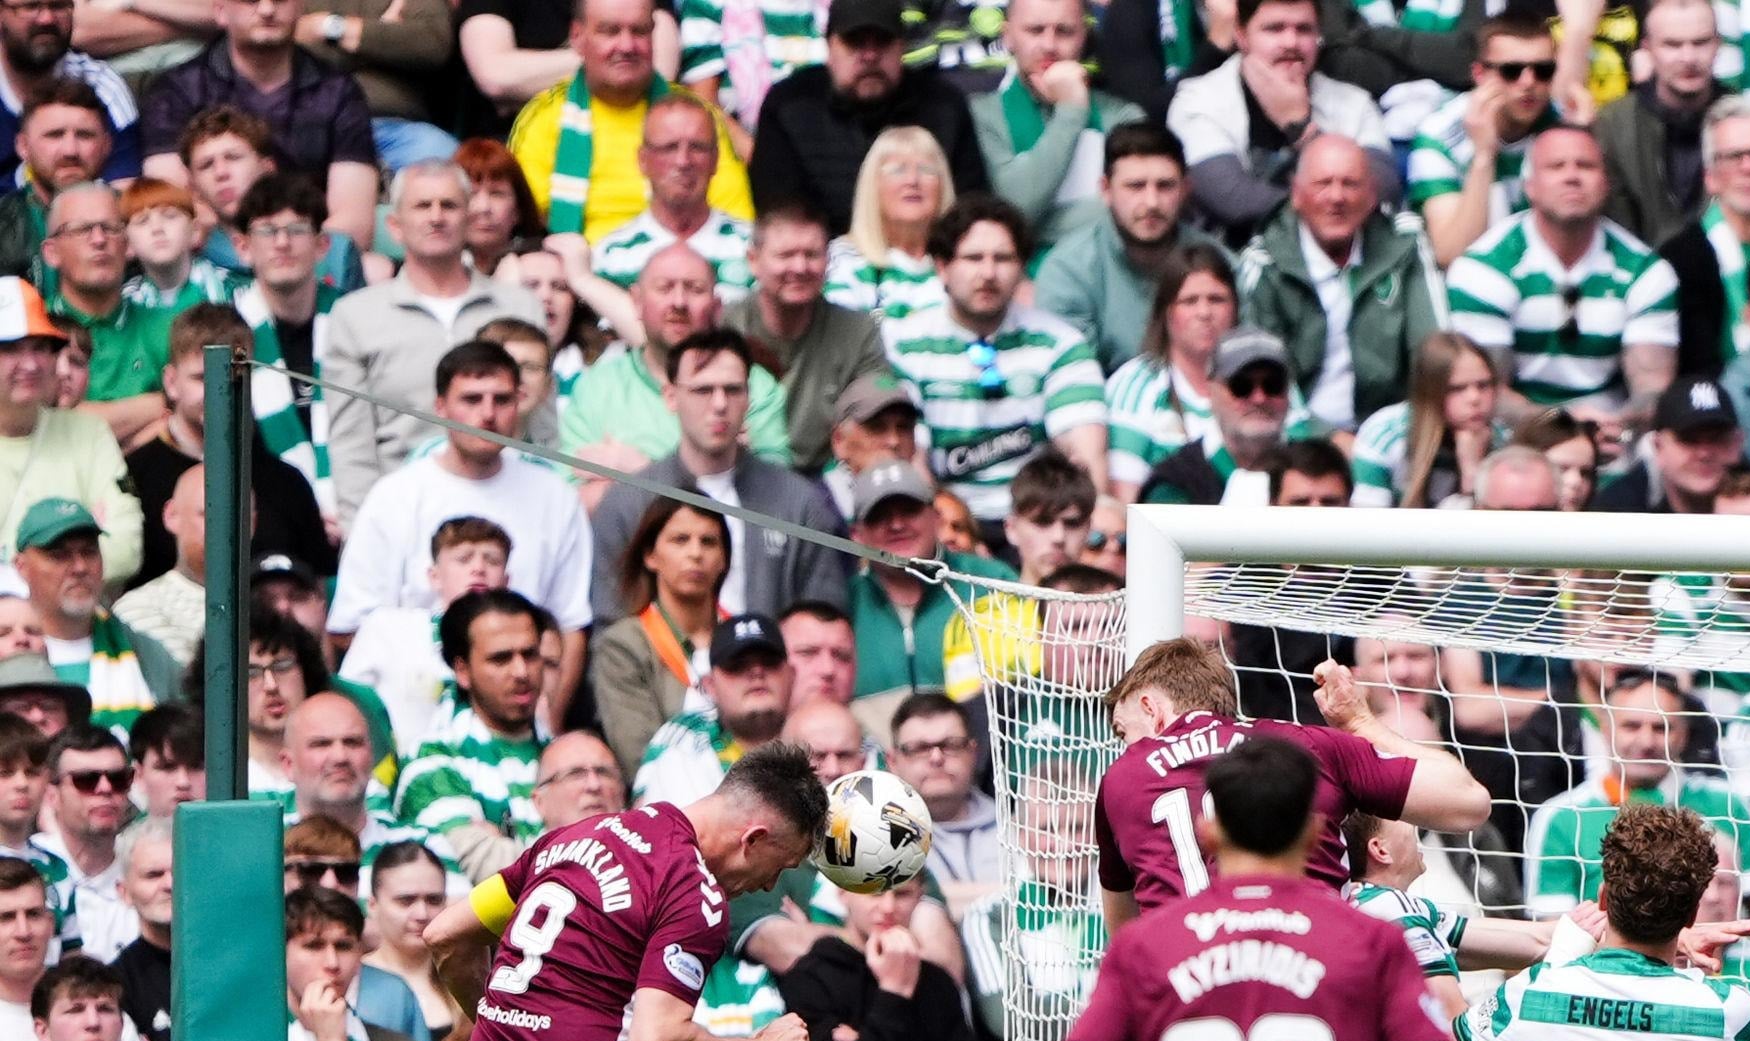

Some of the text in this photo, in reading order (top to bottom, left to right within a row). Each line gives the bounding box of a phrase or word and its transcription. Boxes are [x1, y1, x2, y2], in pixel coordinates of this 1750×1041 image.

[534, 838, 632, 913] SHANKLAND
[1151, 787, 1217, 897] 1
[488, 881, 577, 995] 9
[1566, 995, 1655, 1032] ENGELS
